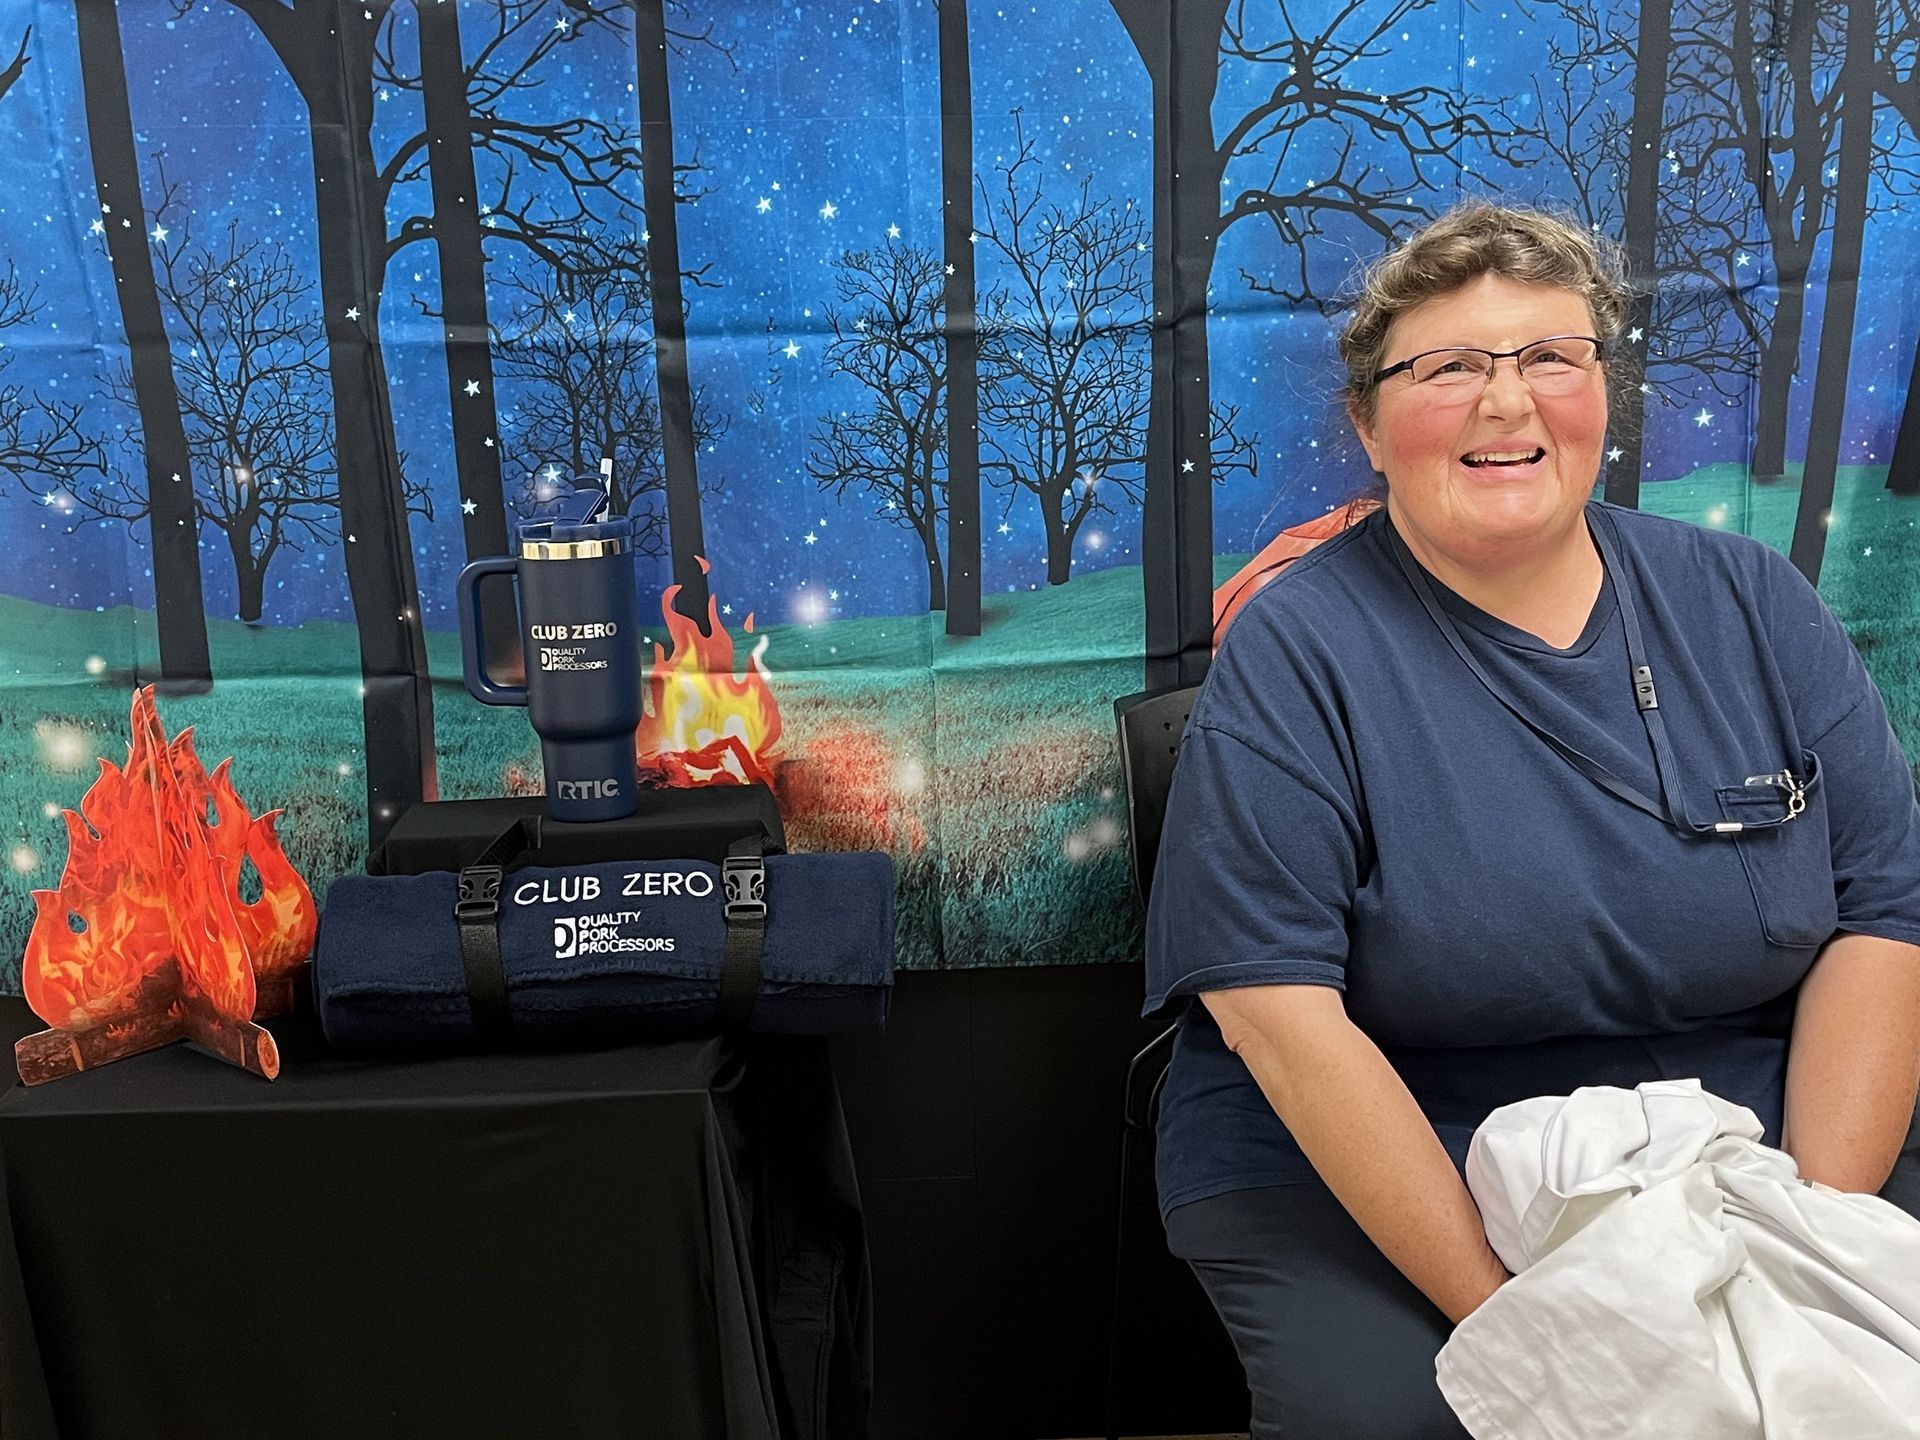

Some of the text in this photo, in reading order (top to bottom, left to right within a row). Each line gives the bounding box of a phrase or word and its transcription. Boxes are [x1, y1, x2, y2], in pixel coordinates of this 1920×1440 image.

[531, 622, 617, 640] CLUB ZERO
[551, 647, 586, 656] QUALITY
[552, 656, 574, 664] PORK
[553, 661, 607, 671] PROCESSORS
[557, 778, 618, 800] RTIC
[514, 871, 714, 905] CLUB ZERO
[578, 911, 641, 929] QUALITY
[579, 927, 620, 942] PORK
[579, 938, 675, 956] PROCESSORS
